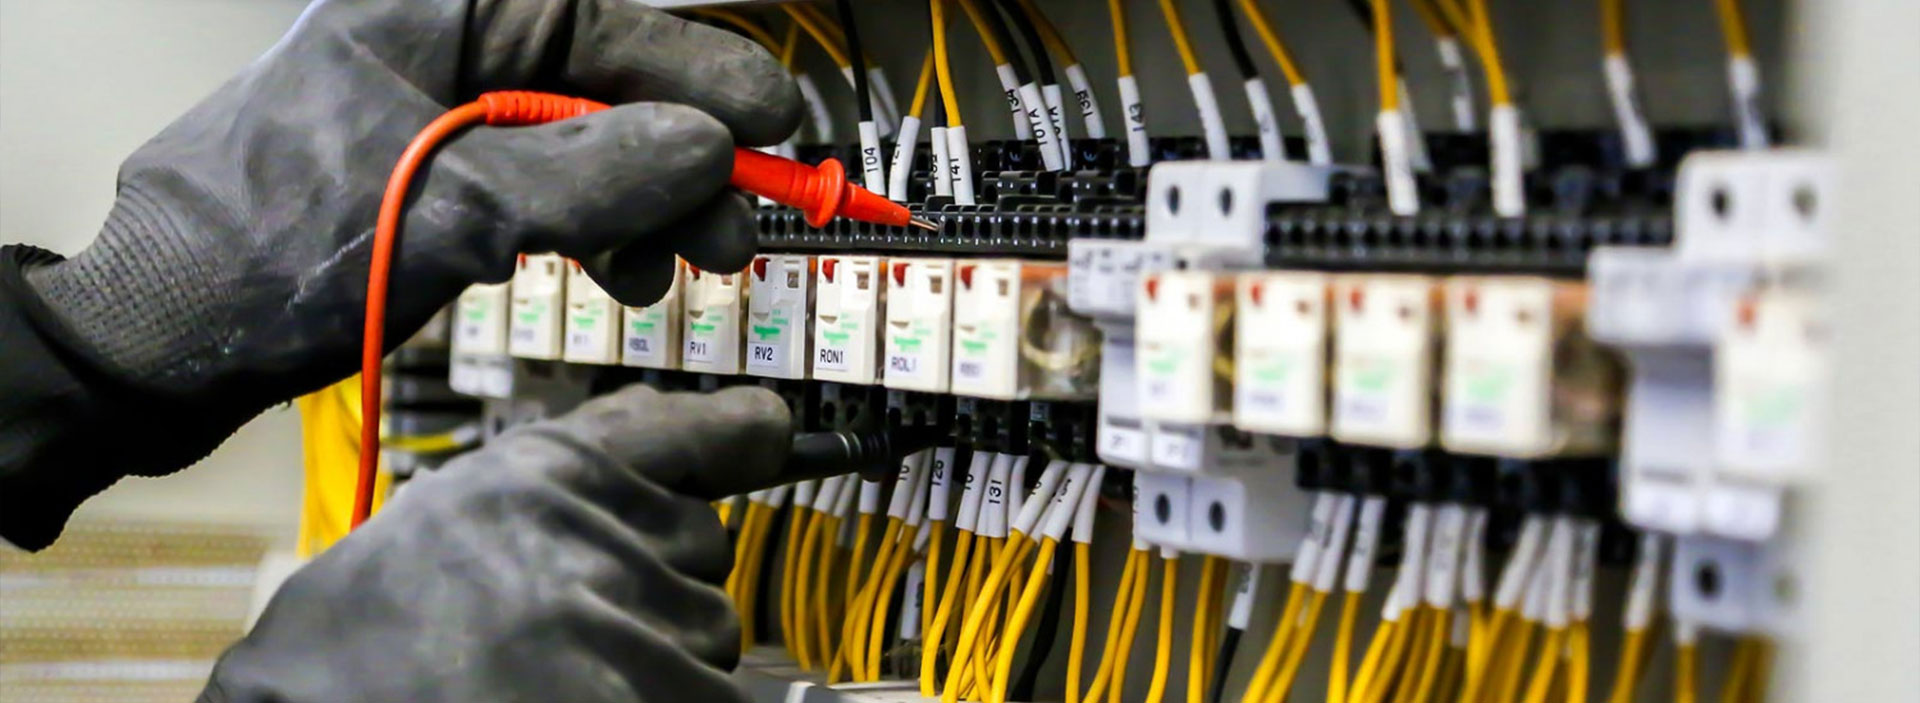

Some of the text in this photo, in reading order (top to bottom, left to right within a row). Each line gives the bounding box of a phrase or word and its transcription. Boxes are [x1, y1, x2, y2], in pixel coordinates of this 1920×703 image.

[1028, 108, 1048, 146] 101A
[864, 147, 879, 172] 104
[950, 158, 961, 182] 141
[690, 341, 706, 356] RV1
[754, 345, 773, 361] RV2
[819, 348, 843, 364] RON1
[988, 479, 1002, 505] 131
